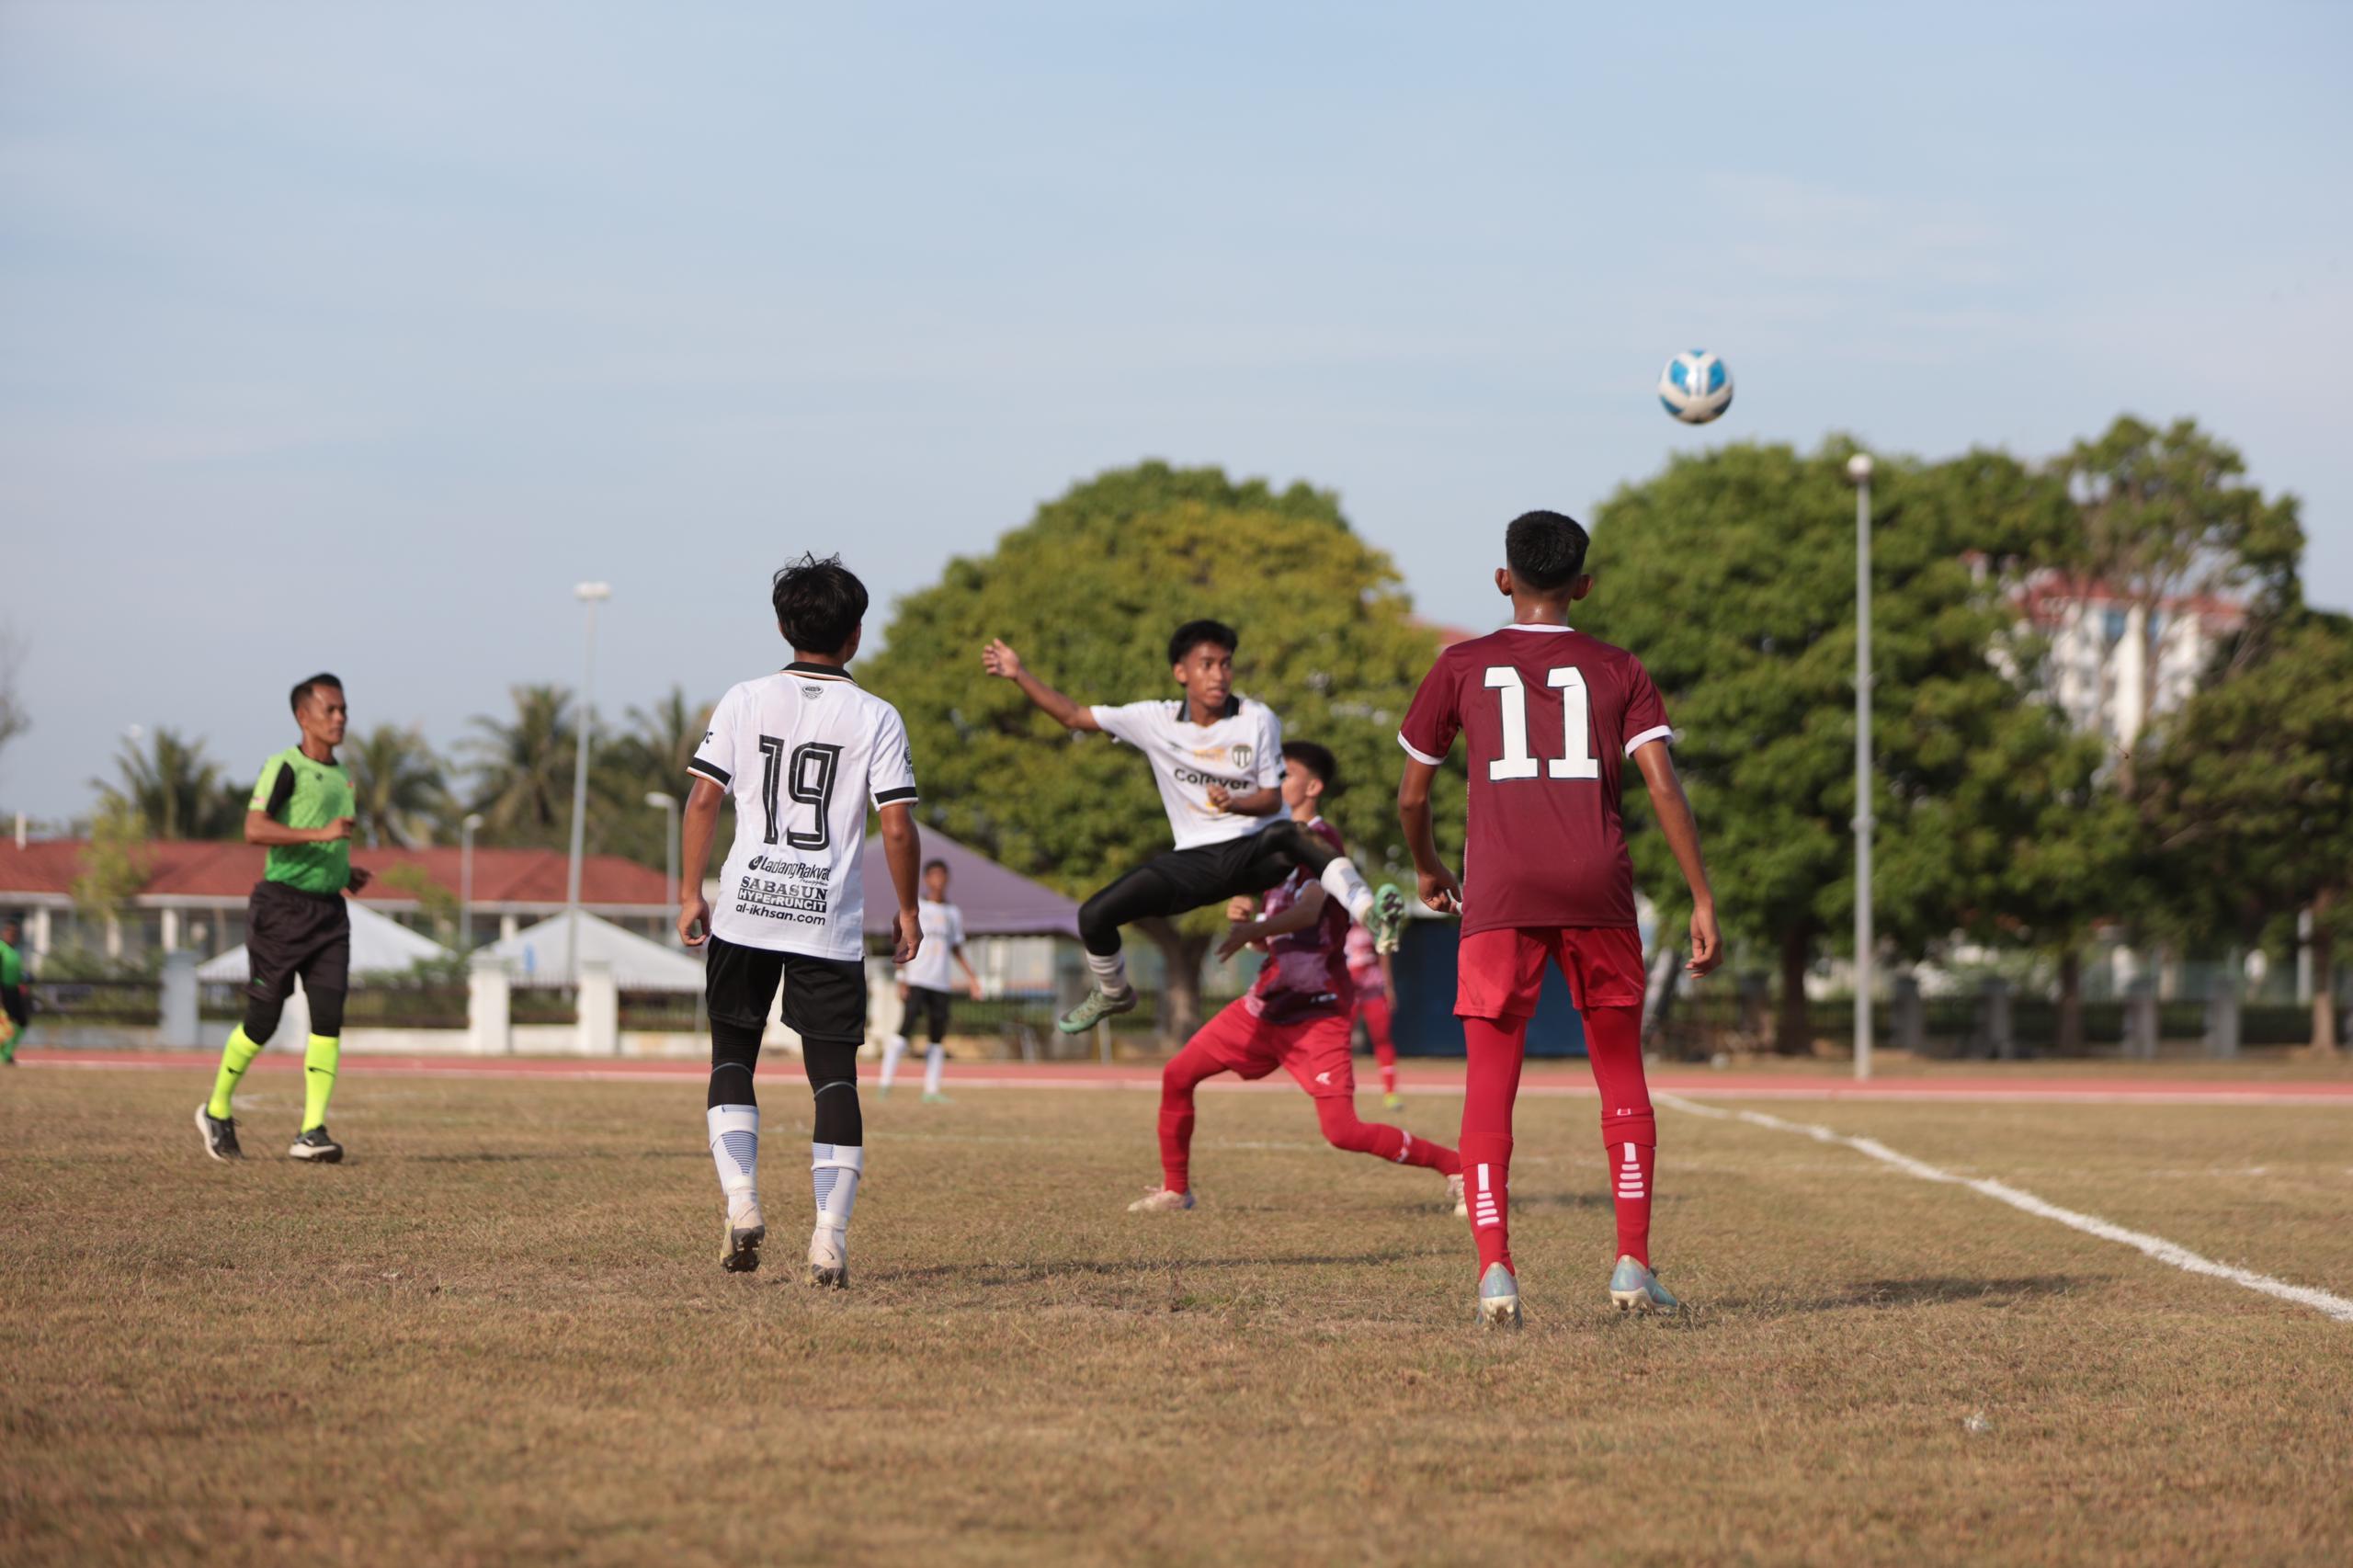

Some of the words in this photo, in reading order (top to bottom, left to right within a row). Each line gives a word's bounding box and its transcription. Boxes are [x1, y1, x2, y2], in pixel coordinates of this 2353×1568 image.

[1483, 666, 1599, 781] 11
[759, 734, 846, 851] 19
[735, 903, 826, 926] al-ikhsan.com
[741, 876, 828, 900] SABASUN
